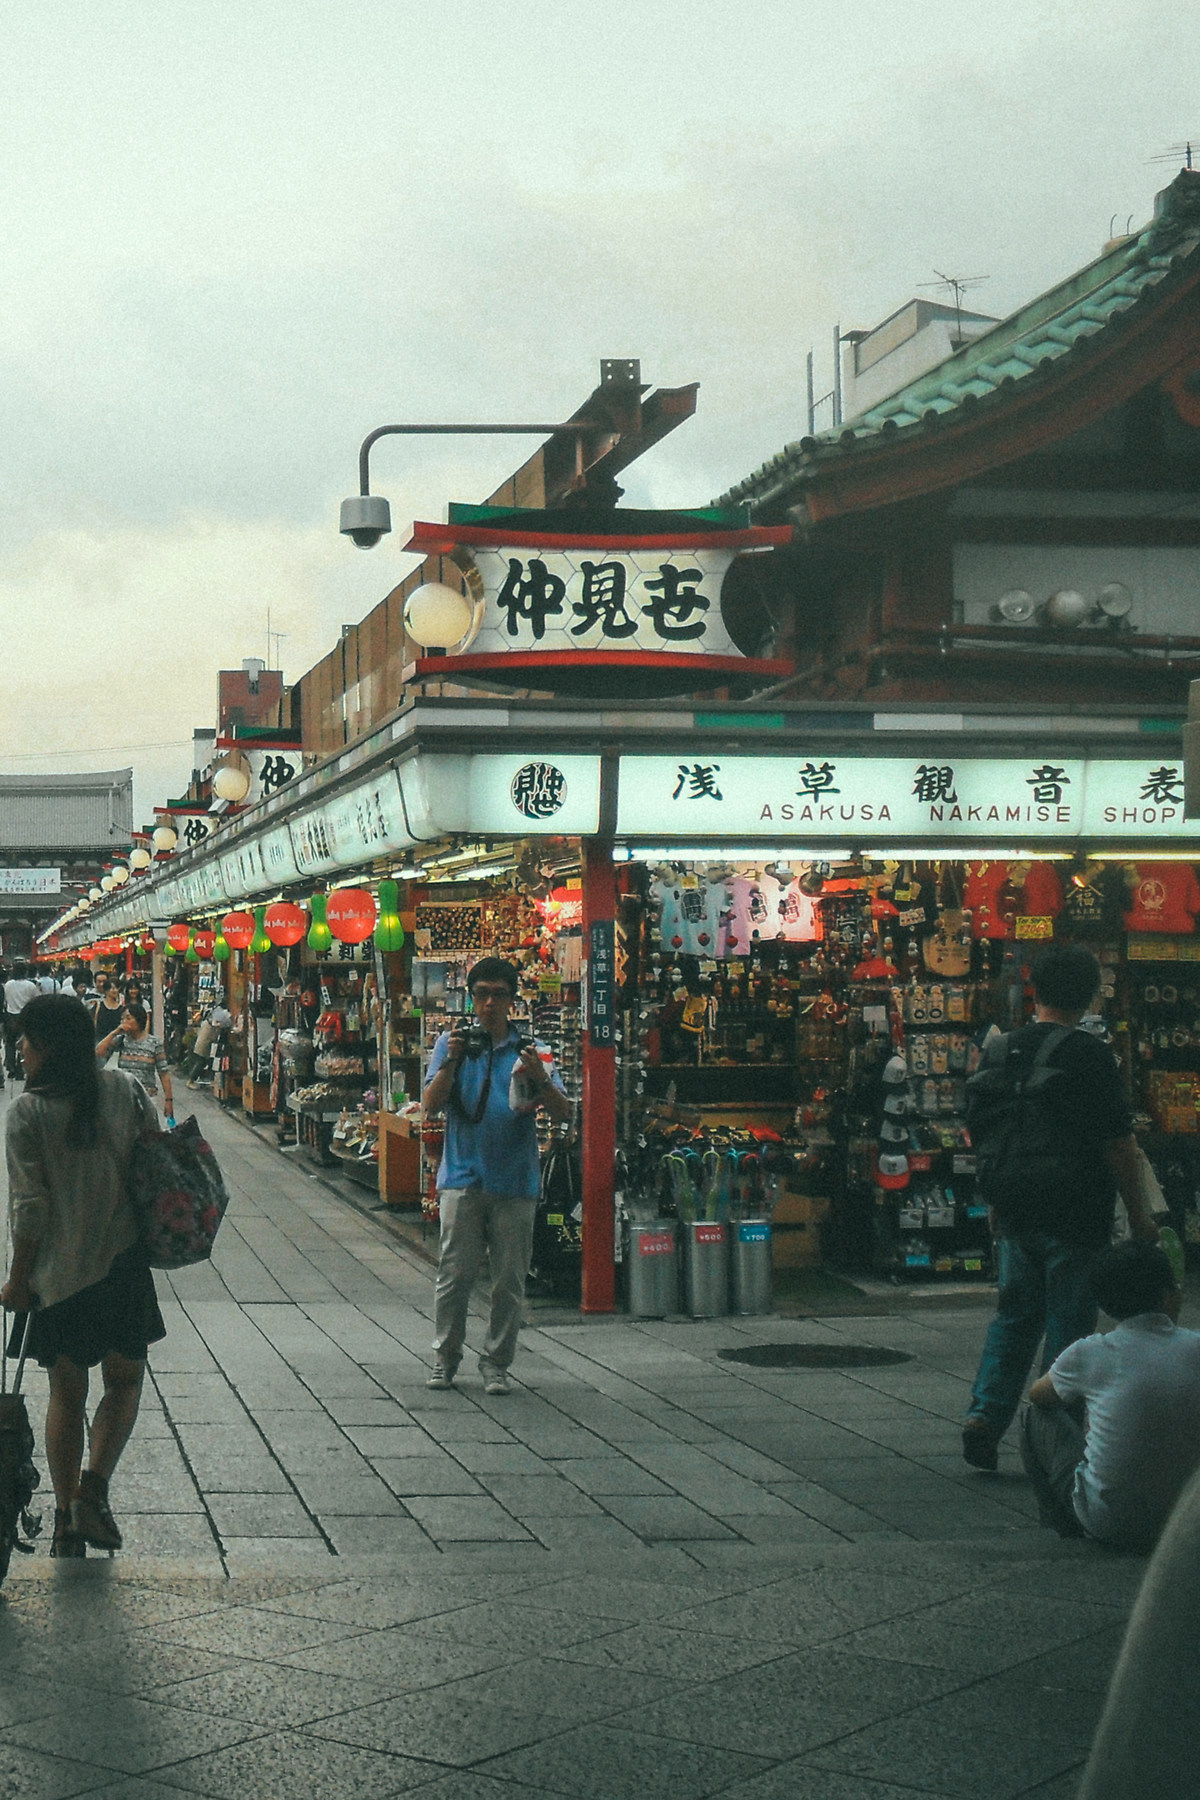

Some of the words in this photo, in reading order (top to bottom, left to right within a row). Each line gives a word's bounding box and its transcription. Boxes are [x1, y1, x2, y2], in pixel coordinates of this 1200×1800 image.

[497, 557, 710, 641] 仲見世
[759, 804, 892, 821] ASAKUSA
[929, 805, 1071, 822] NAKAMISE
[1104, 807, 1186, 823] SHOP
[594, 1025, 610, 1039] 18
